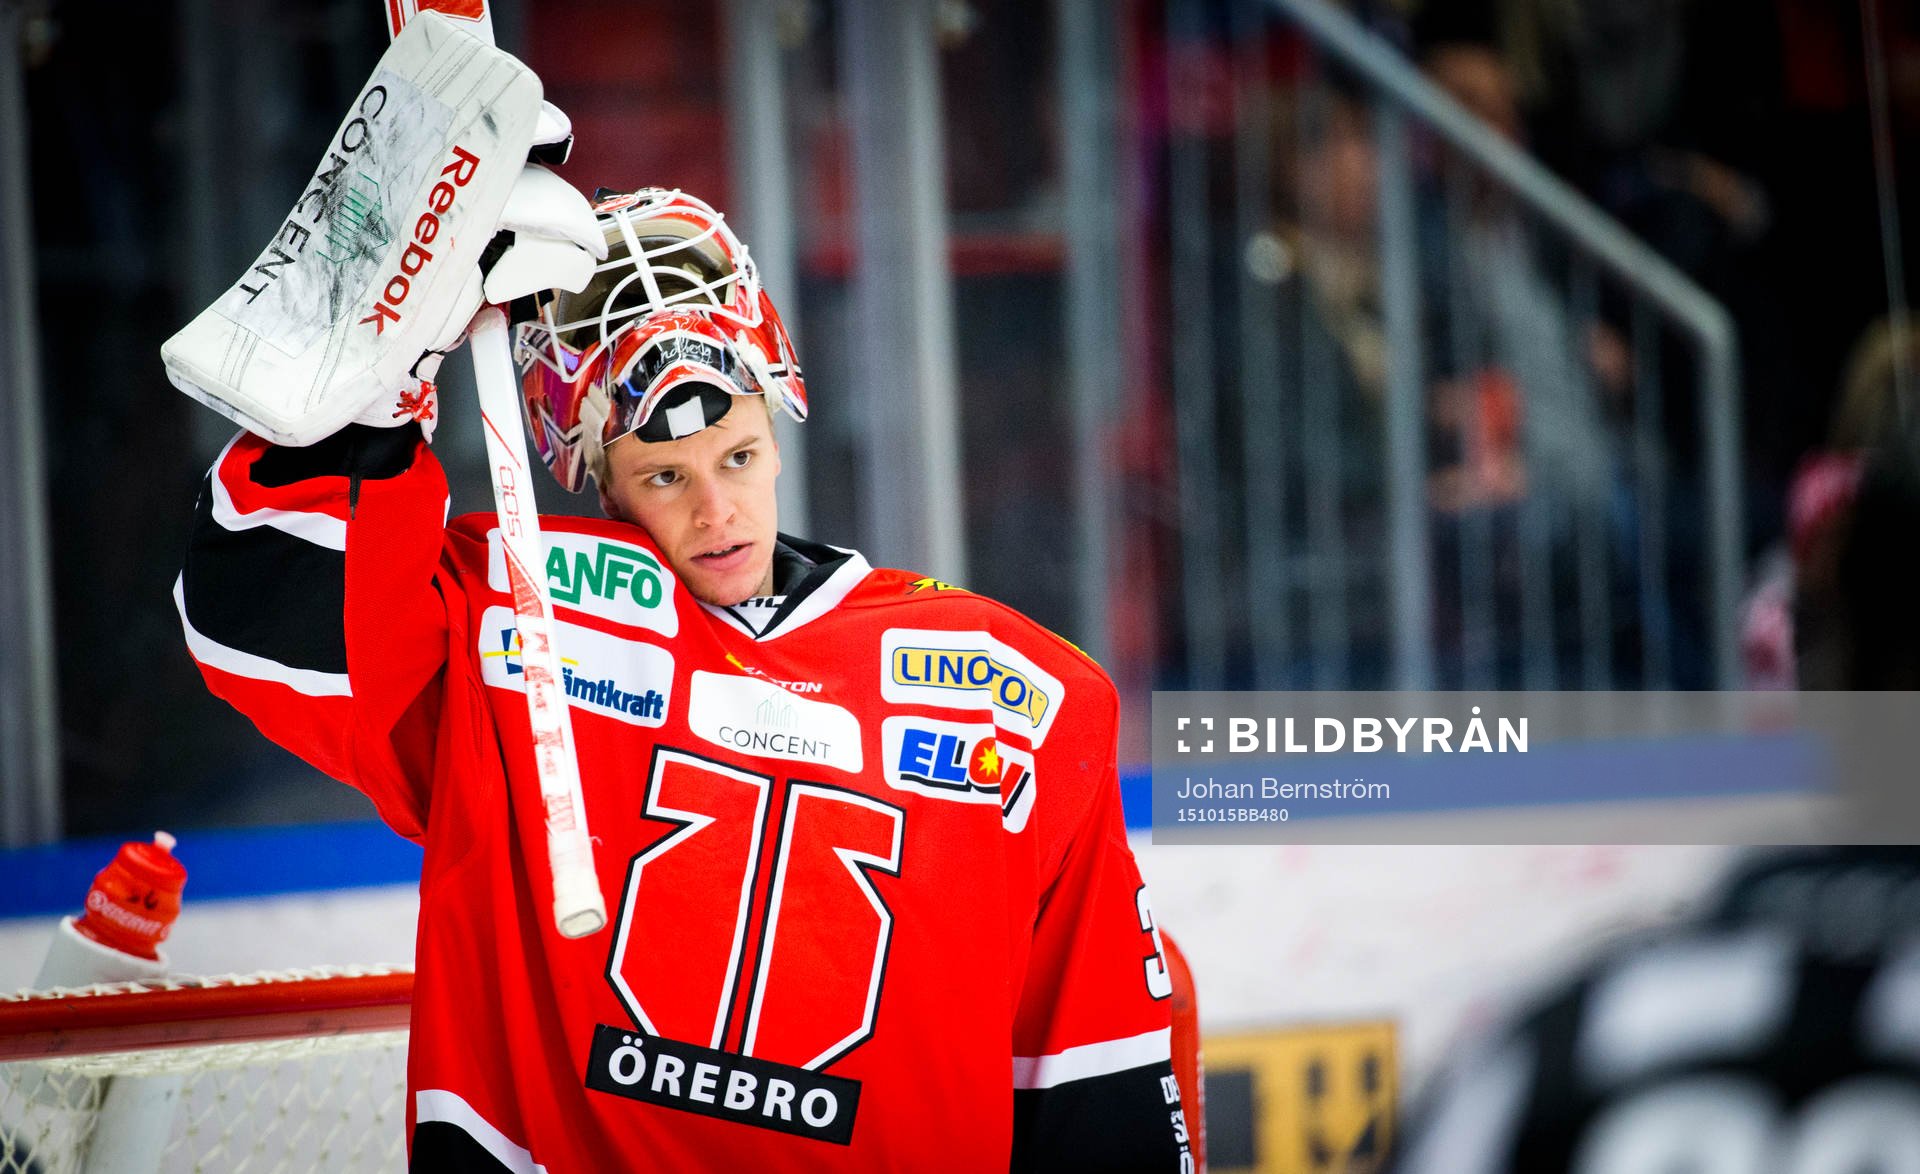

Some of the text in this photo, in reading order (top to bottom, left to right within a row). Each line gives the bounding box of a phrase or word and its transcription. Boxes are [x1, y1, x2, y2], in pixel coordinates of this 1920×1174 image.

[239, 85, 388, 305] CONCENT
[358, 145, 481, 336] Reebok
[545, 542, 663, 609] ANFO
[562, 667, 664, 720] ämtkraft
[719, 726, 831, 759] CONCENT
[608, 1035, 839, 1128] ÖREBRO
